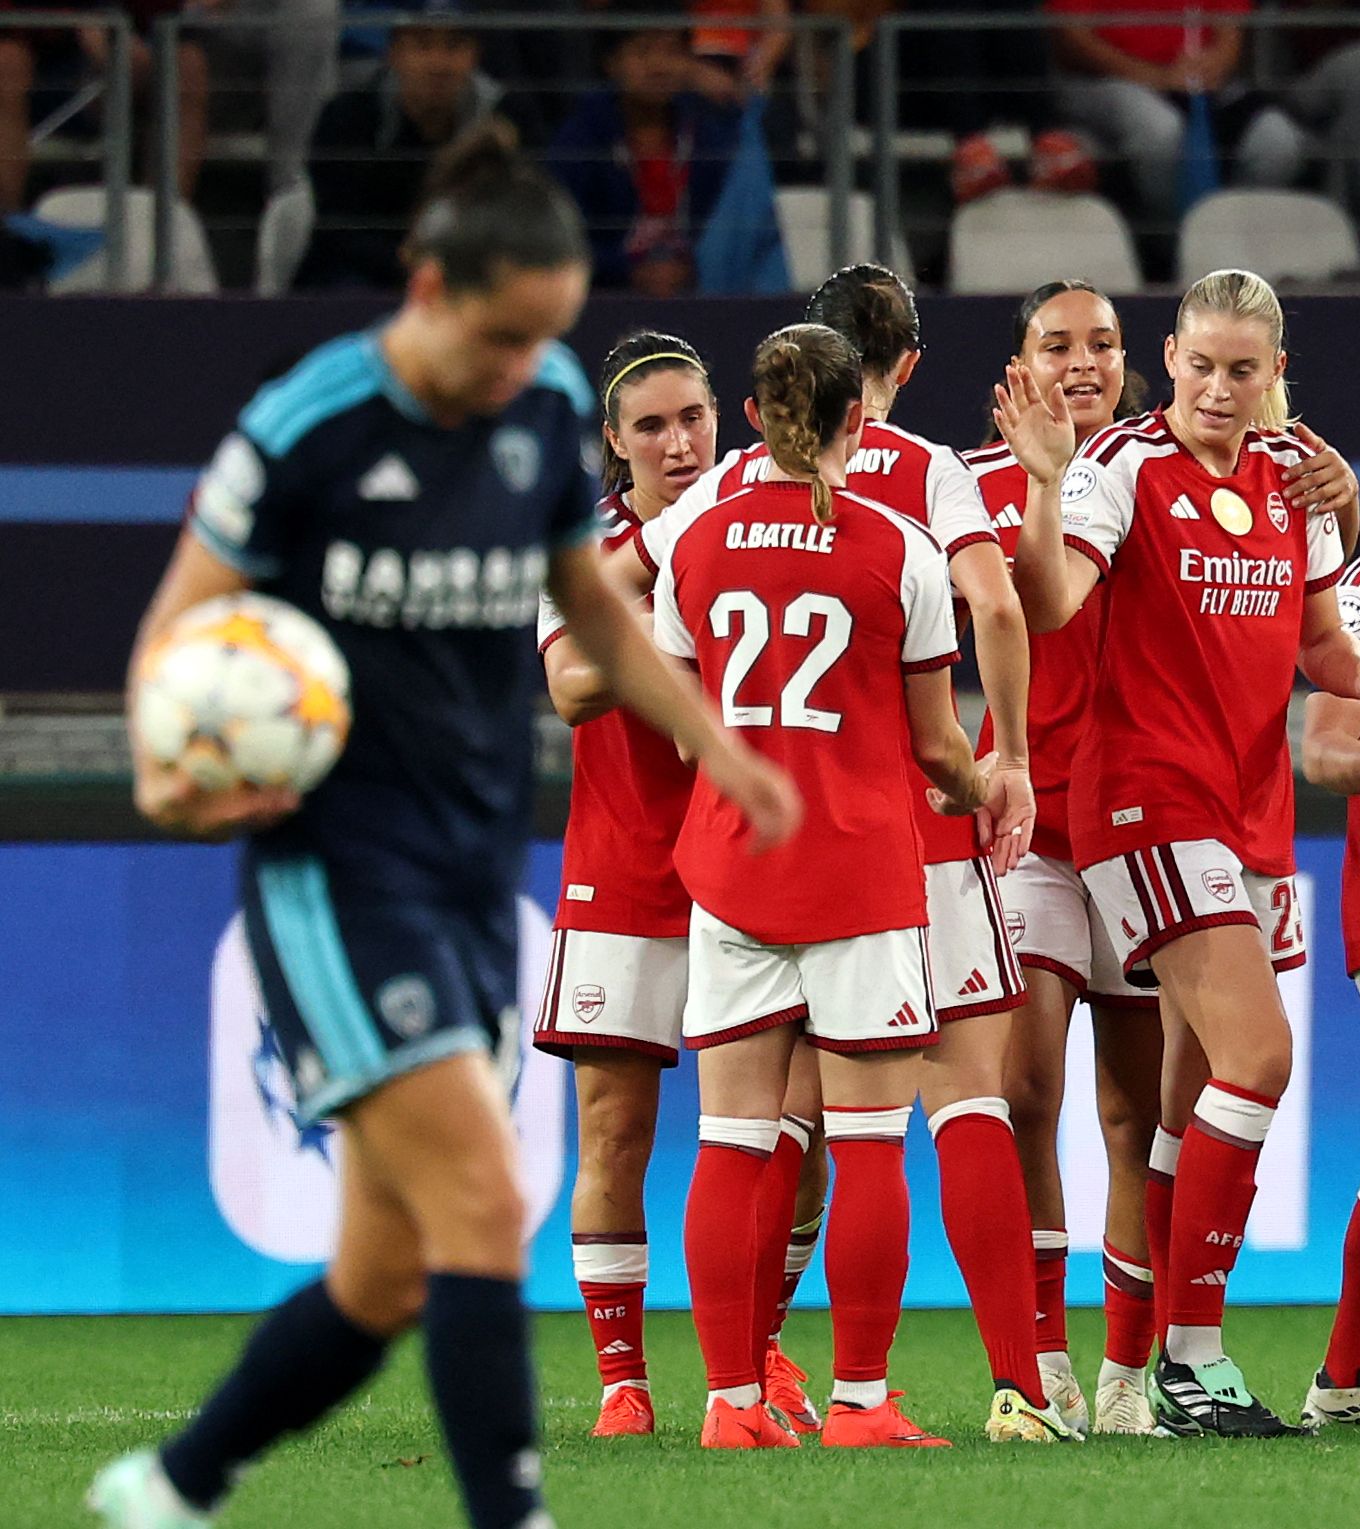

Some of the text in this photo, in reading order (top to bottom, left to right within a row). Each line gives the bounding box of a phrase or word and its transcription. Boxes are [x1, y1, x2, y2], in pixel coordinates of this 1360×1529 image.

[725, 521, 837, 554] O.BATLLE
[1179, 548, 1293, 587] Emirates
[1200, 587, 1280, 616] FLY BETTER
[708, 589, 854, 733] 22
[593, 1305, 626, 1320] AFC
